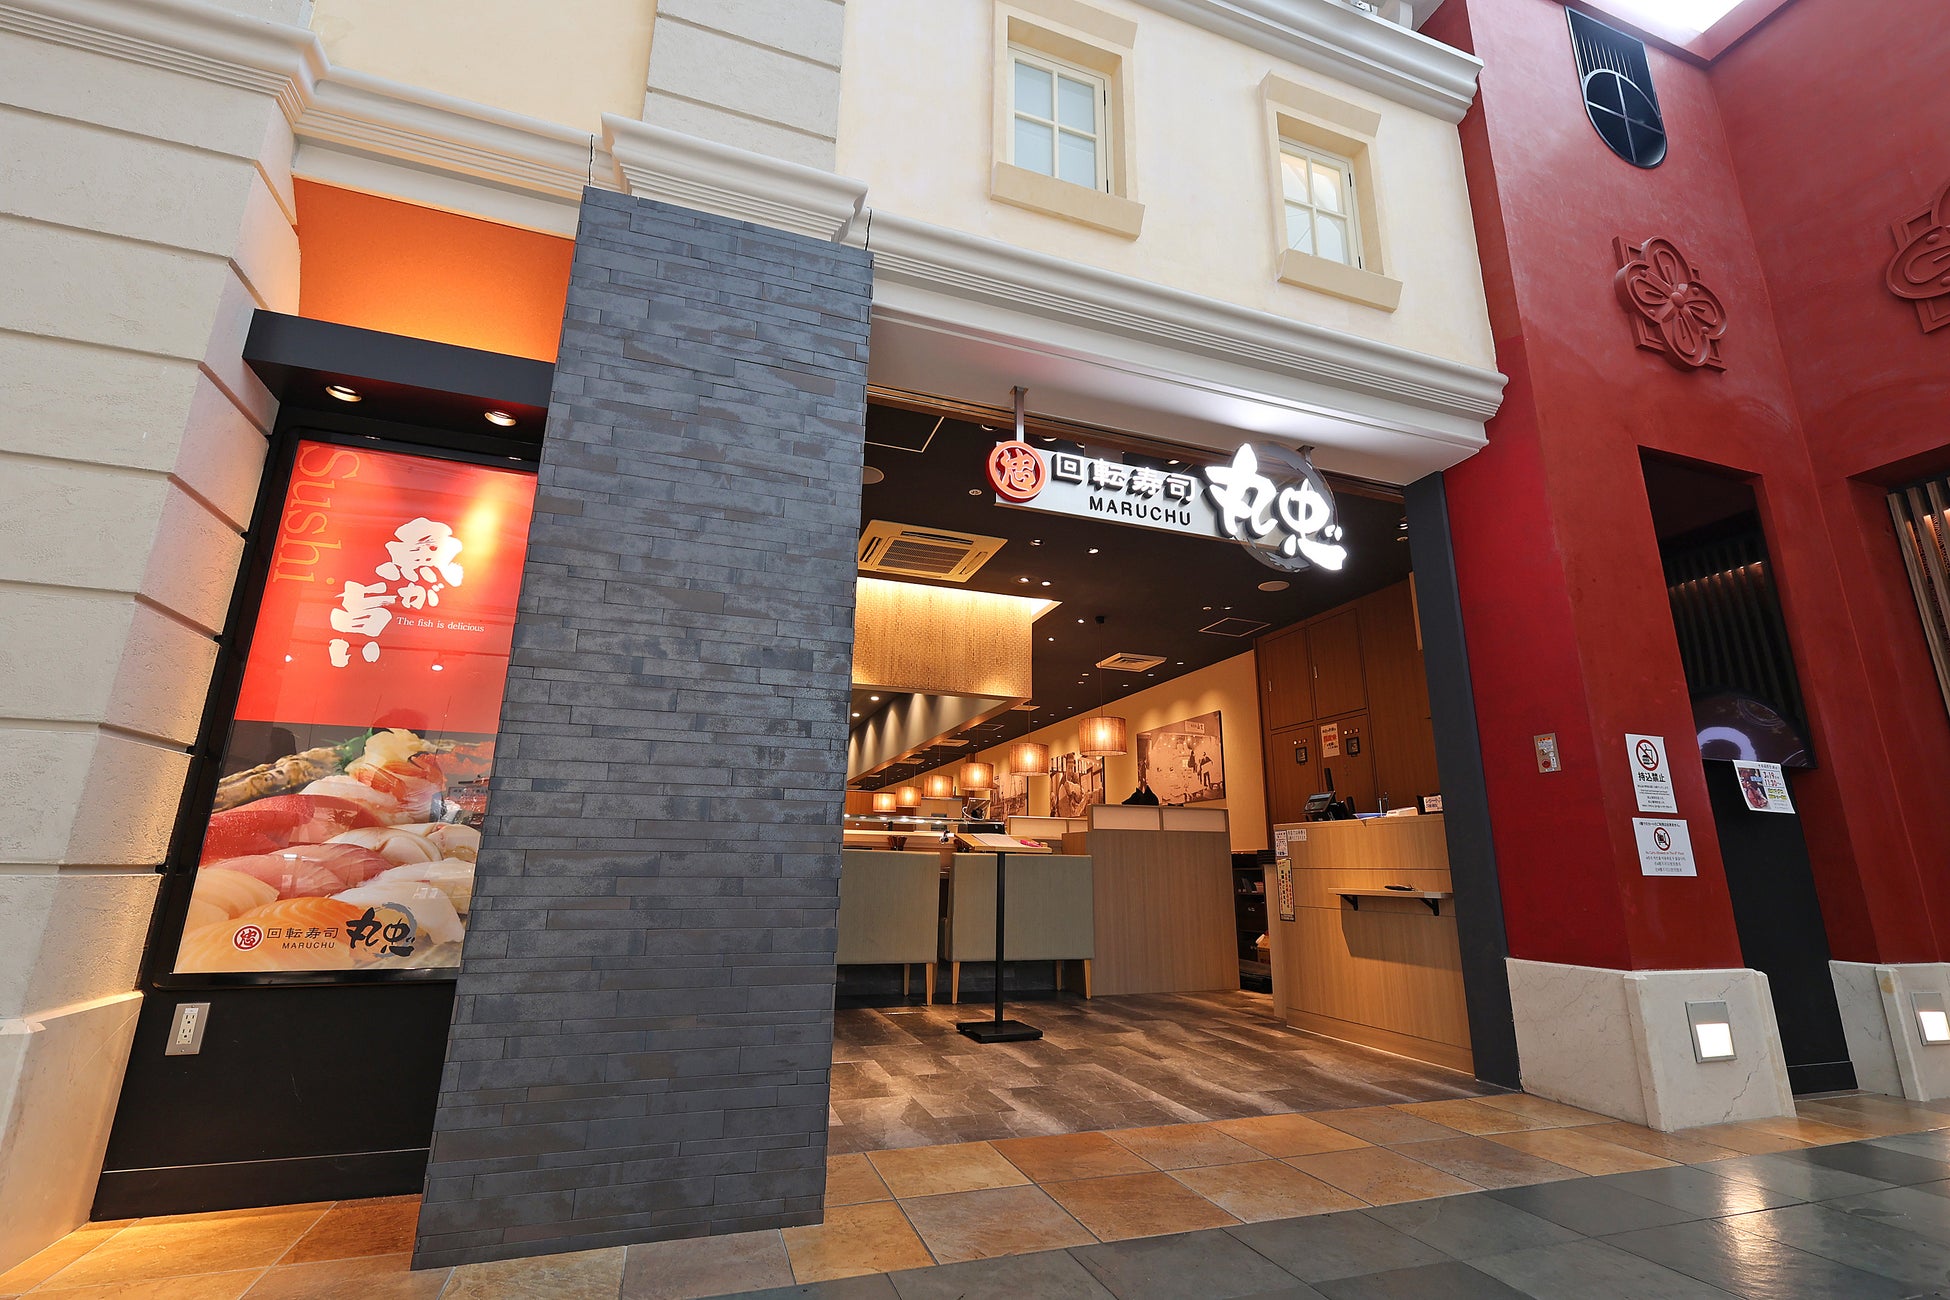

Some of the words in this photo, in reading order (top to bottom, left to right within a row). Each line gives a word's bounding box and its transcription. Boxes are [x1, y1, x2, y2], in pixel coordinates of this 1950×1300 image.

[1052, 452, 1197, 502] 回転寿司
[273, 445, 360, 584] Sushi
[1089, 495, 1192, 527] MARUCHU
[1204, 443, 1348, 571] 丸忠
[396, 616, 415, 626] The
[417, 618, 434, 628] fish
[436, 620, 445, 629] is
[447, 621, 485, 632] delicious
[1638, 772, 1666, 783] 持込禁止
[266, 927, 339, 940] 回転寿司
[281, 941, 336, 950] MARUCHU
[346, 907, 416, 957] 丸忠
